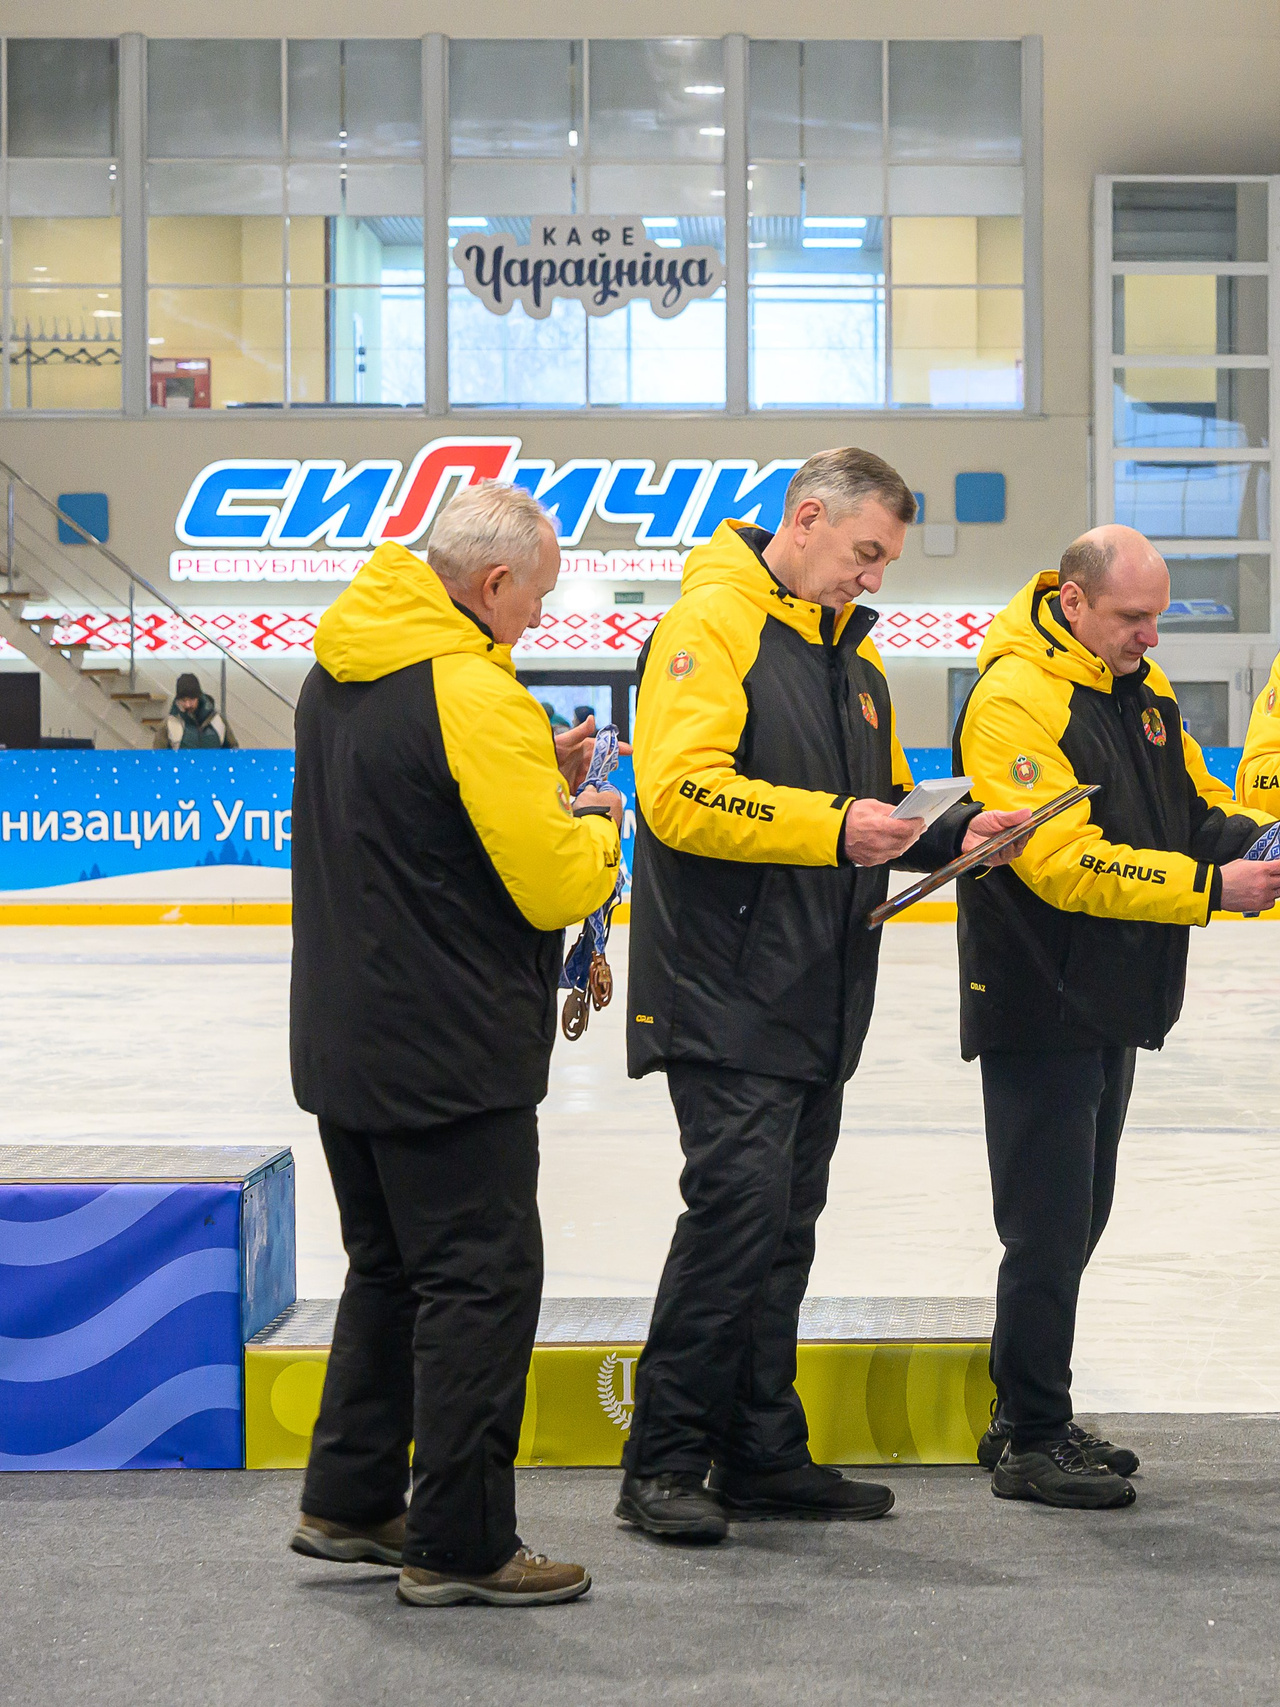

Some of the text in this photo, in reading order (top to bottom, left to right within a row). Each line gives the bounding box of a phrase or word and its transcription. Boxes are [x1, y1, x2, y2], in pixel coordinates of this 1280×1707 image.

[543, 227, 634, 246] КАФЕ
[465, 245, 713, 308] Чараўніца
[2, 800, 292, 851] низаций Упр
